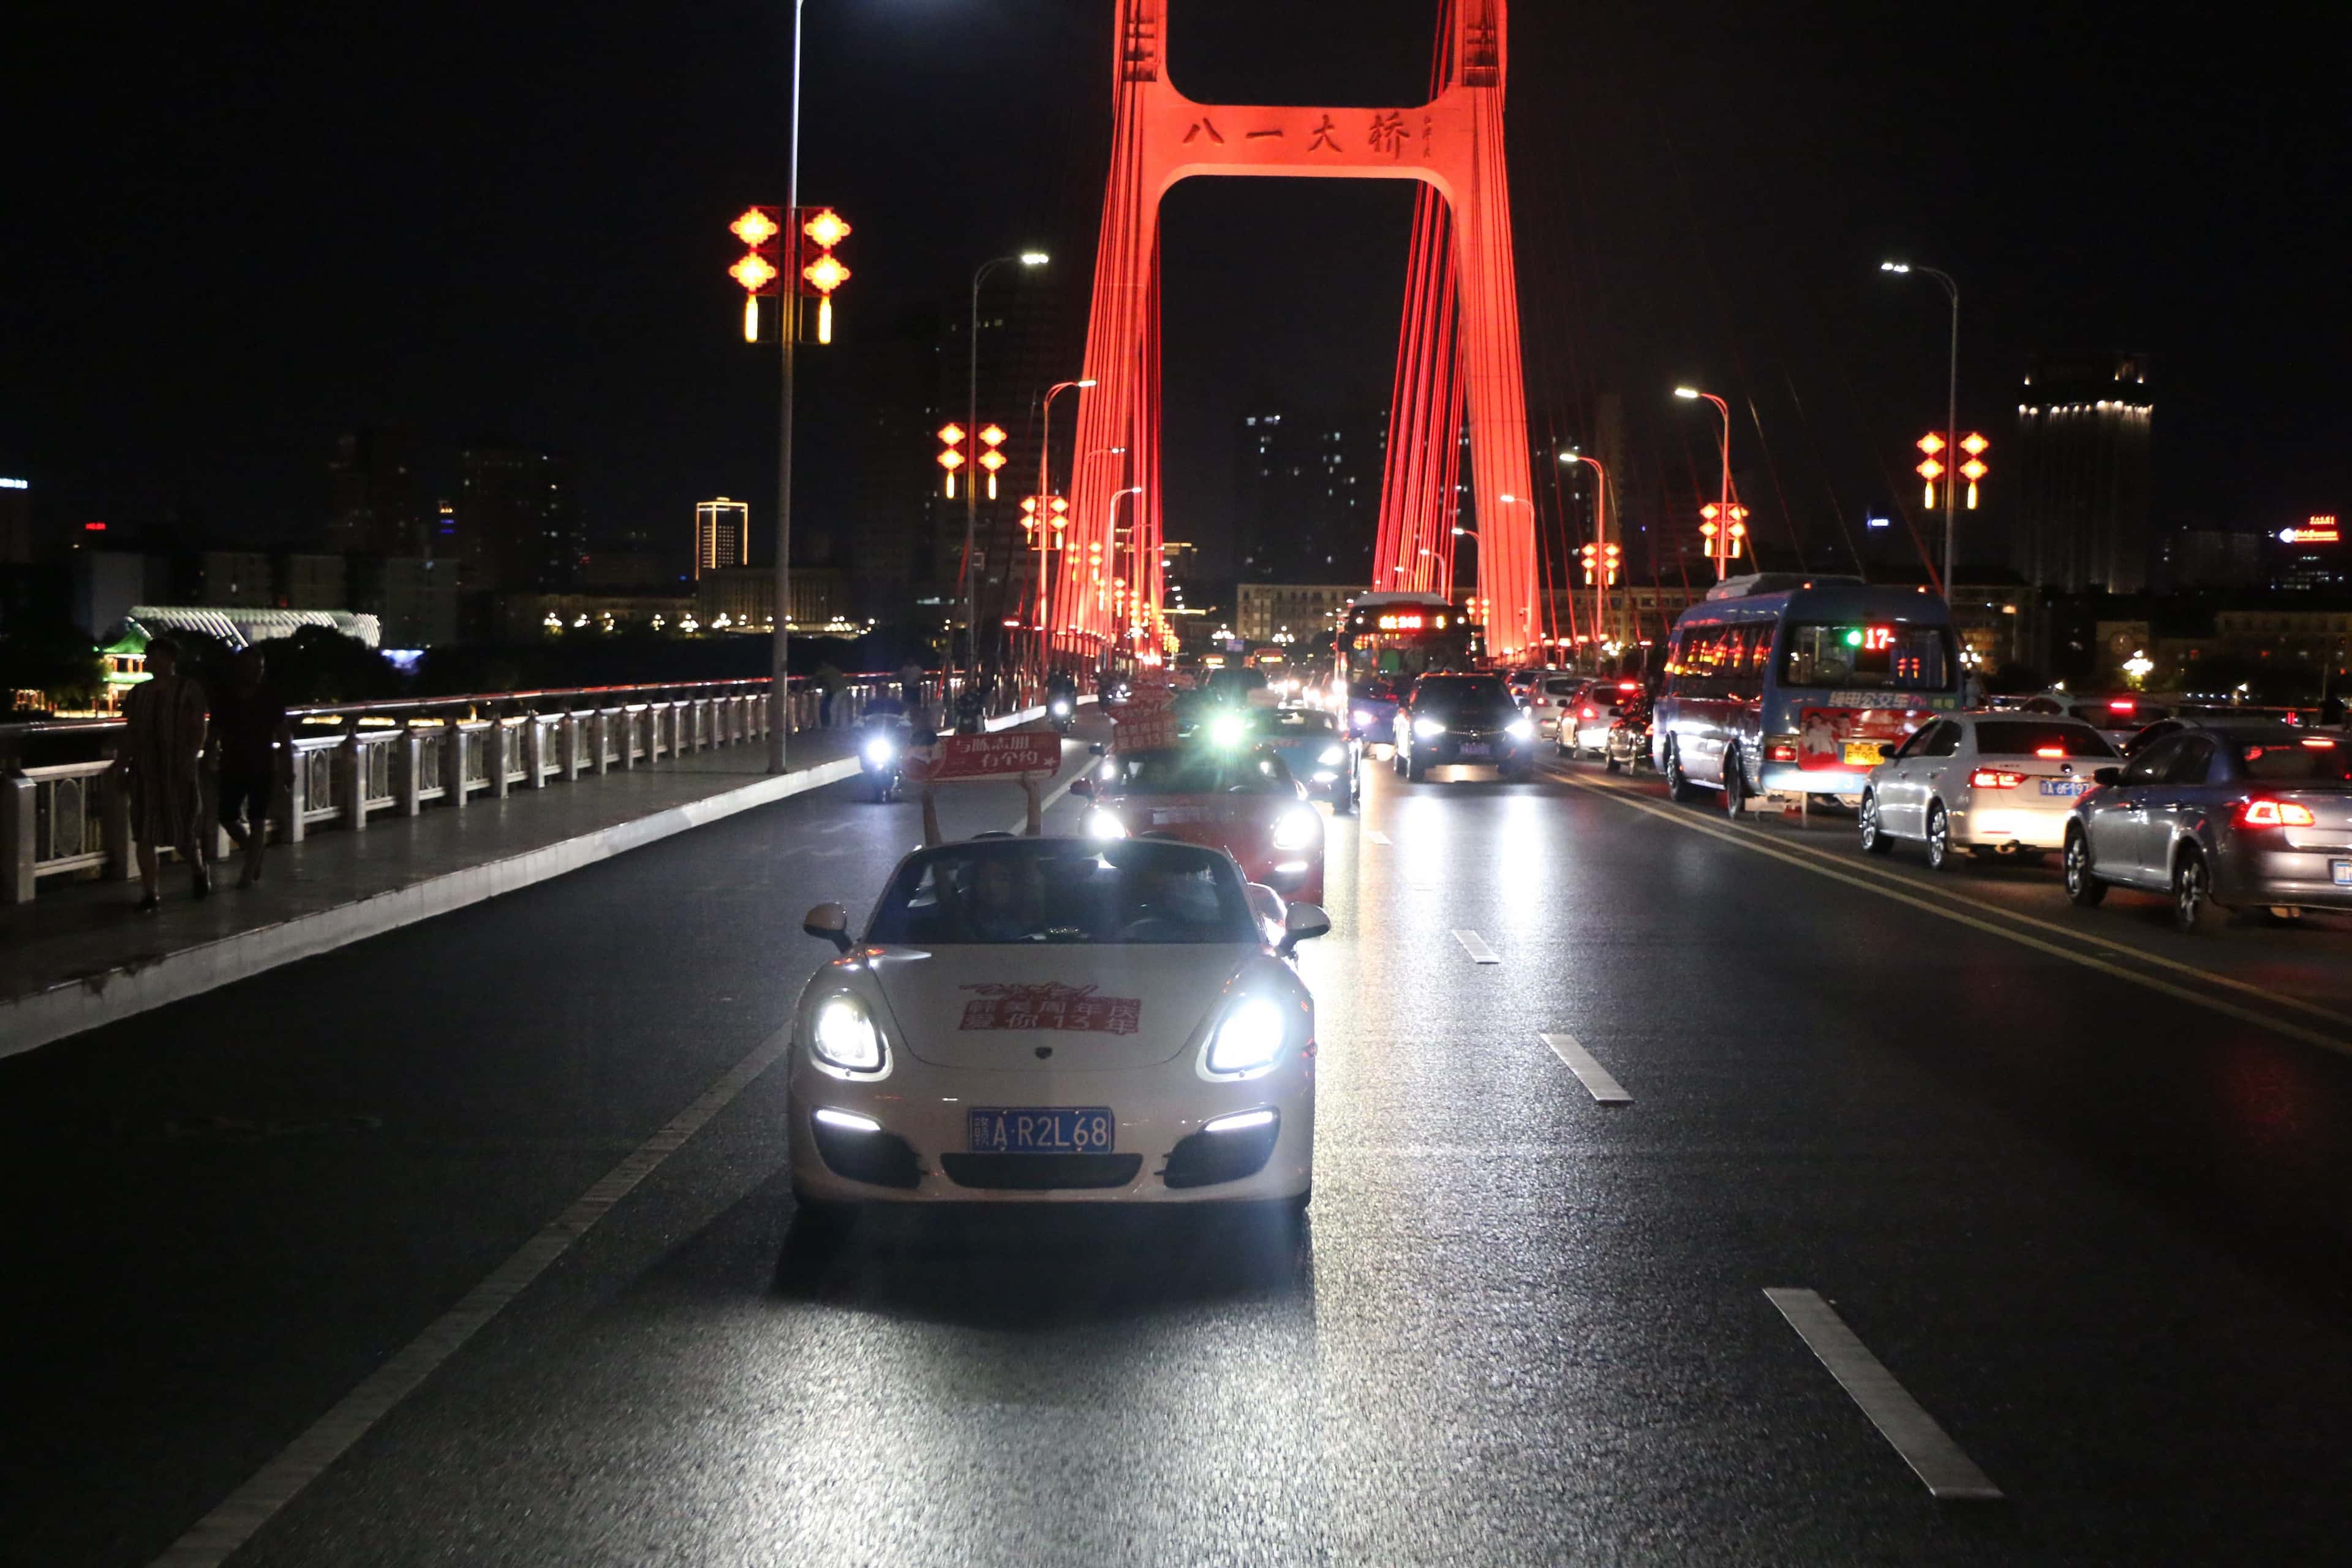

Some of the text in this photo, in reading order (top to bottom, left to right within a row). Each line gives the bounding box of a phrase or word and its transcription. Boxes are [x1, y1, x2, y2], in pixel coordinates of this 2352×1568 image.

[1183, 111, 1411, 160] 八一大桥
[1865, 628, 1889, 649] 17
